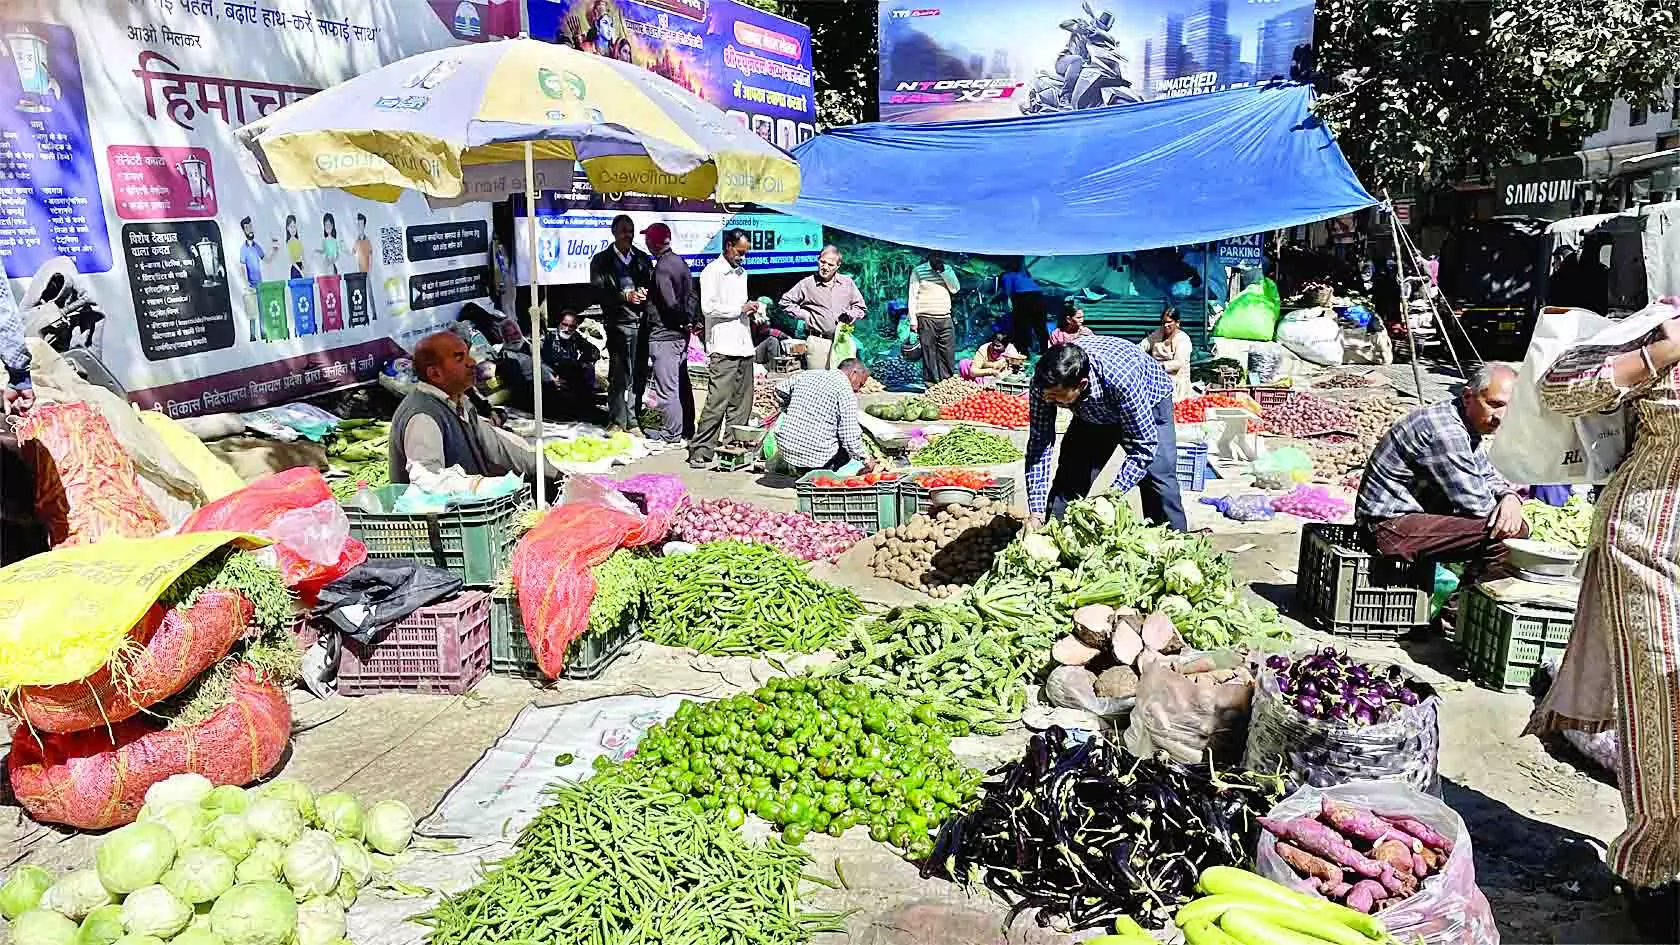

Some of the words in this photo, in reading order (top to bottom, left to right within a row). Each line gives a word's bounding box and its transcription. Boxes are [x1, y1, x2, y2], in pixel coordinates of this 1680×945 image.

[127, 24, 158, 43] आओ
[161, 25, 202, 48] मिलकर
[316, 17, 350, 43] सफाई
[132, 50, 324, 130] हिमाच
[722, 216, 751, 227] Sponsored
[751, 216, 759, 227] by
[151, 231, 177, 243] देखभाल
[131, 247, 149, 256] वाला
[567, 240, 598, 259] Uday
[1220, 246, 1260, 258] PARKING
[167, 399, 200, 417] विकास
[249, 378, 281, 398] हिमाचल
[283, 371, 303, 389] प्रदेश
[305, 369, 321, 384] द्वारा
[322, 361, 348, 377] जनहित
[358, 354, 374, 369] जारी
